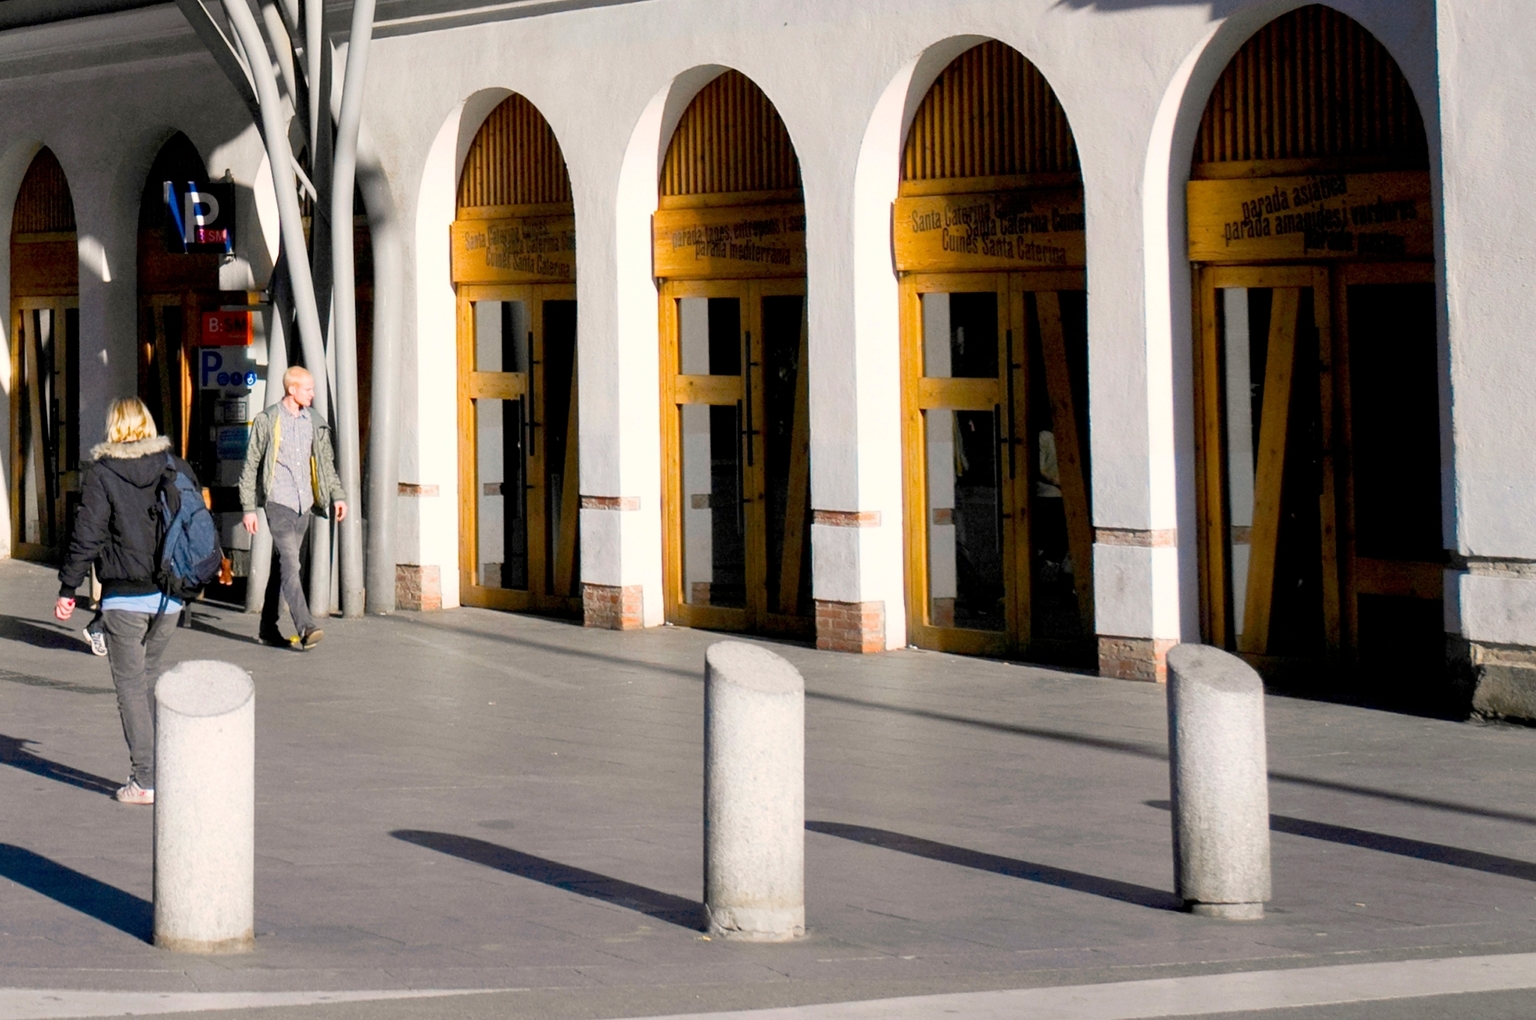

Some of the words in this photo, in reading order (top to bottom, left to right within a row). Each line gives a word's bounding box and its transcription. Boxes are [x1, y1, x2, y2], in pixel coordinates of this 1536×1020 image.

[184, 192, 220, 243] P
[912, 209, 942, 233] Santa
[944, 201, 990, 227] Caterina
[1242, 185, 1289, 220] parada
[966, 215, 996, 238] Santa
[1000, 212, 1048, 235] Caterina
[1224, 214, 1271, 247] parada
[1351, 196, 1418, 226] verdures
[465, 231, 486, 251] Santa
[672, 224, 702, 252] parada
[695, 239, 726, 261] parada
[942, 227, 978, 255] Cuines
[982, 232, 1014, 259] Santa
[1017, 235, 1067, 265] Caterina
[486, 246, 511, 269] Cuines
[513, 251, 535, 273] Santa
[537, 254, 571, 279] Caterina
[208, 317, 247, 333] B:SM
[201, 351, 223, 387] P
